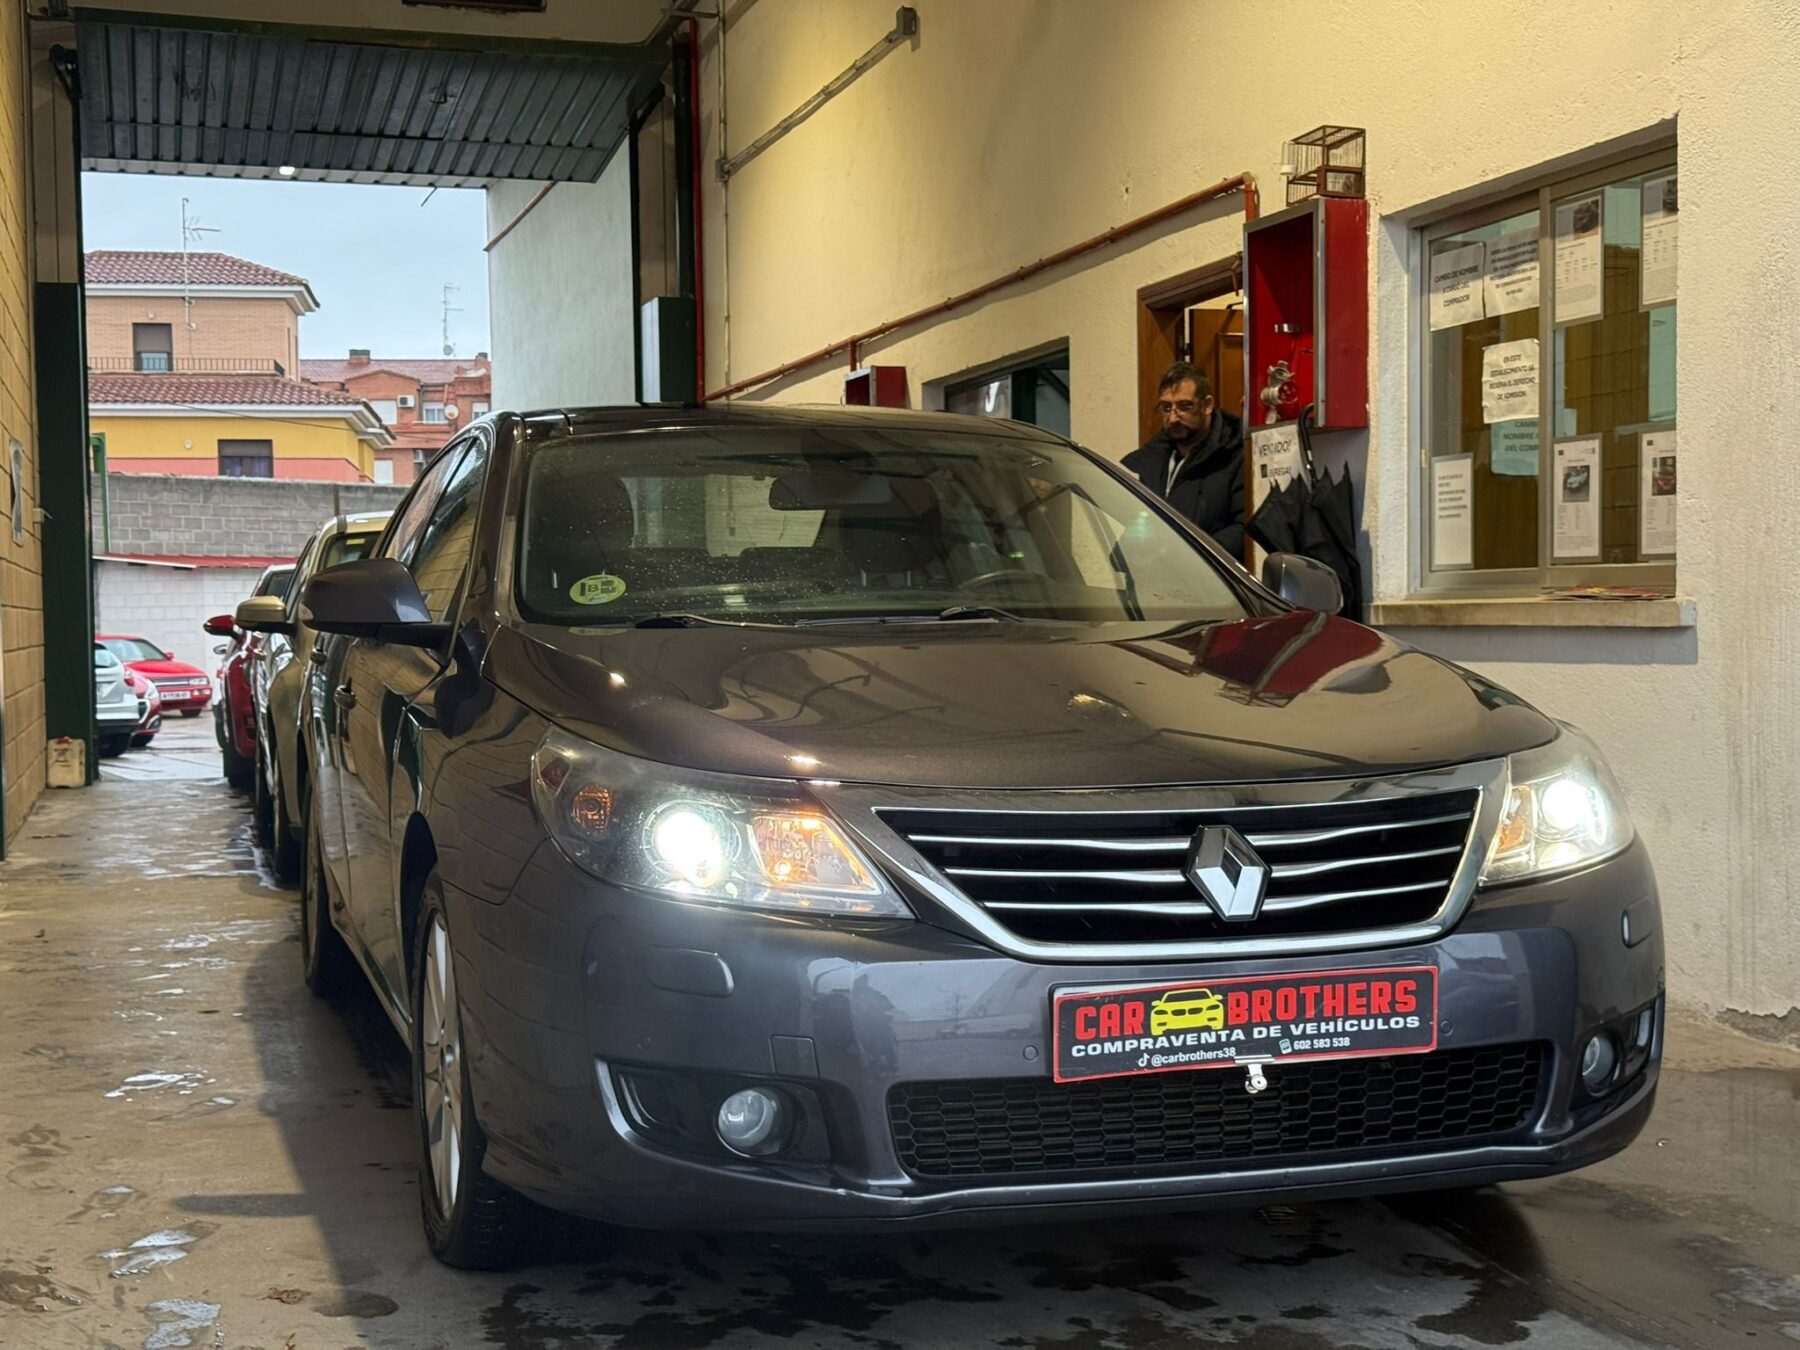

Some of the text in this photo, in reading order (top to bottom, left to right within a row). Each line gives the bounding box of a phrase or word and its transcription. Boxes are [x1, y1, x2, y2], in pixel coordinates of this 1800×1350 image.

[588, 584, 599, 593] B
[1075, 980, 1417, 1040] CAR BROTHERS
[1071, 1015, 1421, 1057] COMPRAVENTA DE VEHÍCULOS
[1293, 1036, 1350, 1050] 602 583 538
[1151, 1047, 1236, 1067] @carbrothers38
